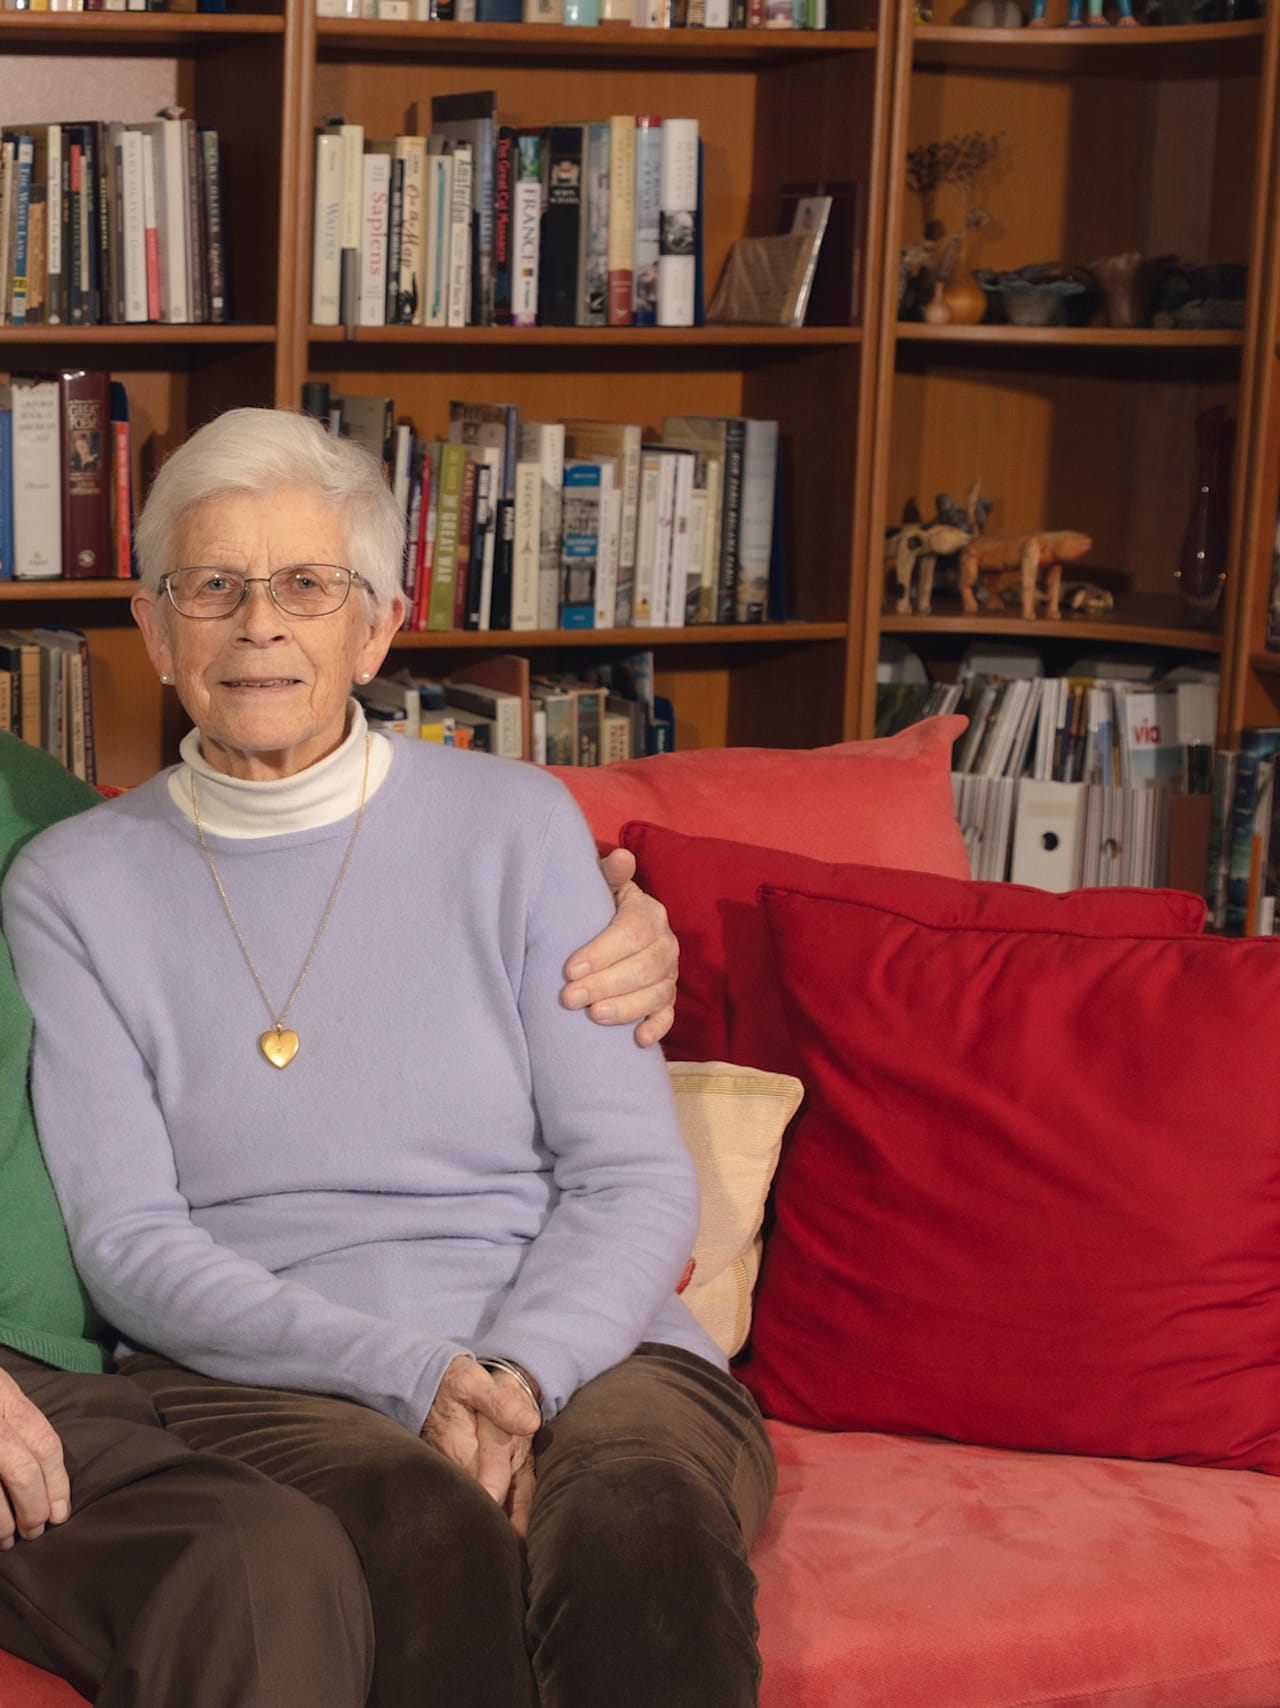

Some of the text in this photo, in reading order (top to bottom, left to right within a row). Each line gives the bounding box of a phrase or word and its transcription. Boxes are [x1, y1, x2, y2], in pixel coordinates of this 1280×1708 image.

[128, 140, 138, 176] MARY
[208, 147, 219, 181] MARY
[16, 168, 30, 260] THE WASTE LAND
[129, 181, 139, 233] OLIVER
[209, 185, 220, 233] OLIVER
[452, 159, 473, 224] Amsterdam
[497, 138, 511, 263] The Great Cat Massacre
[325, 202, 340, 261] WALDEN
[367, 191, 389, 276] Sapiens
[402, 220, 420, 270] Map
[521, 188, 538, 262] FRANCE
[438, 512, 458, 553] GREAT
[435, 556, 454, 584] WAR
